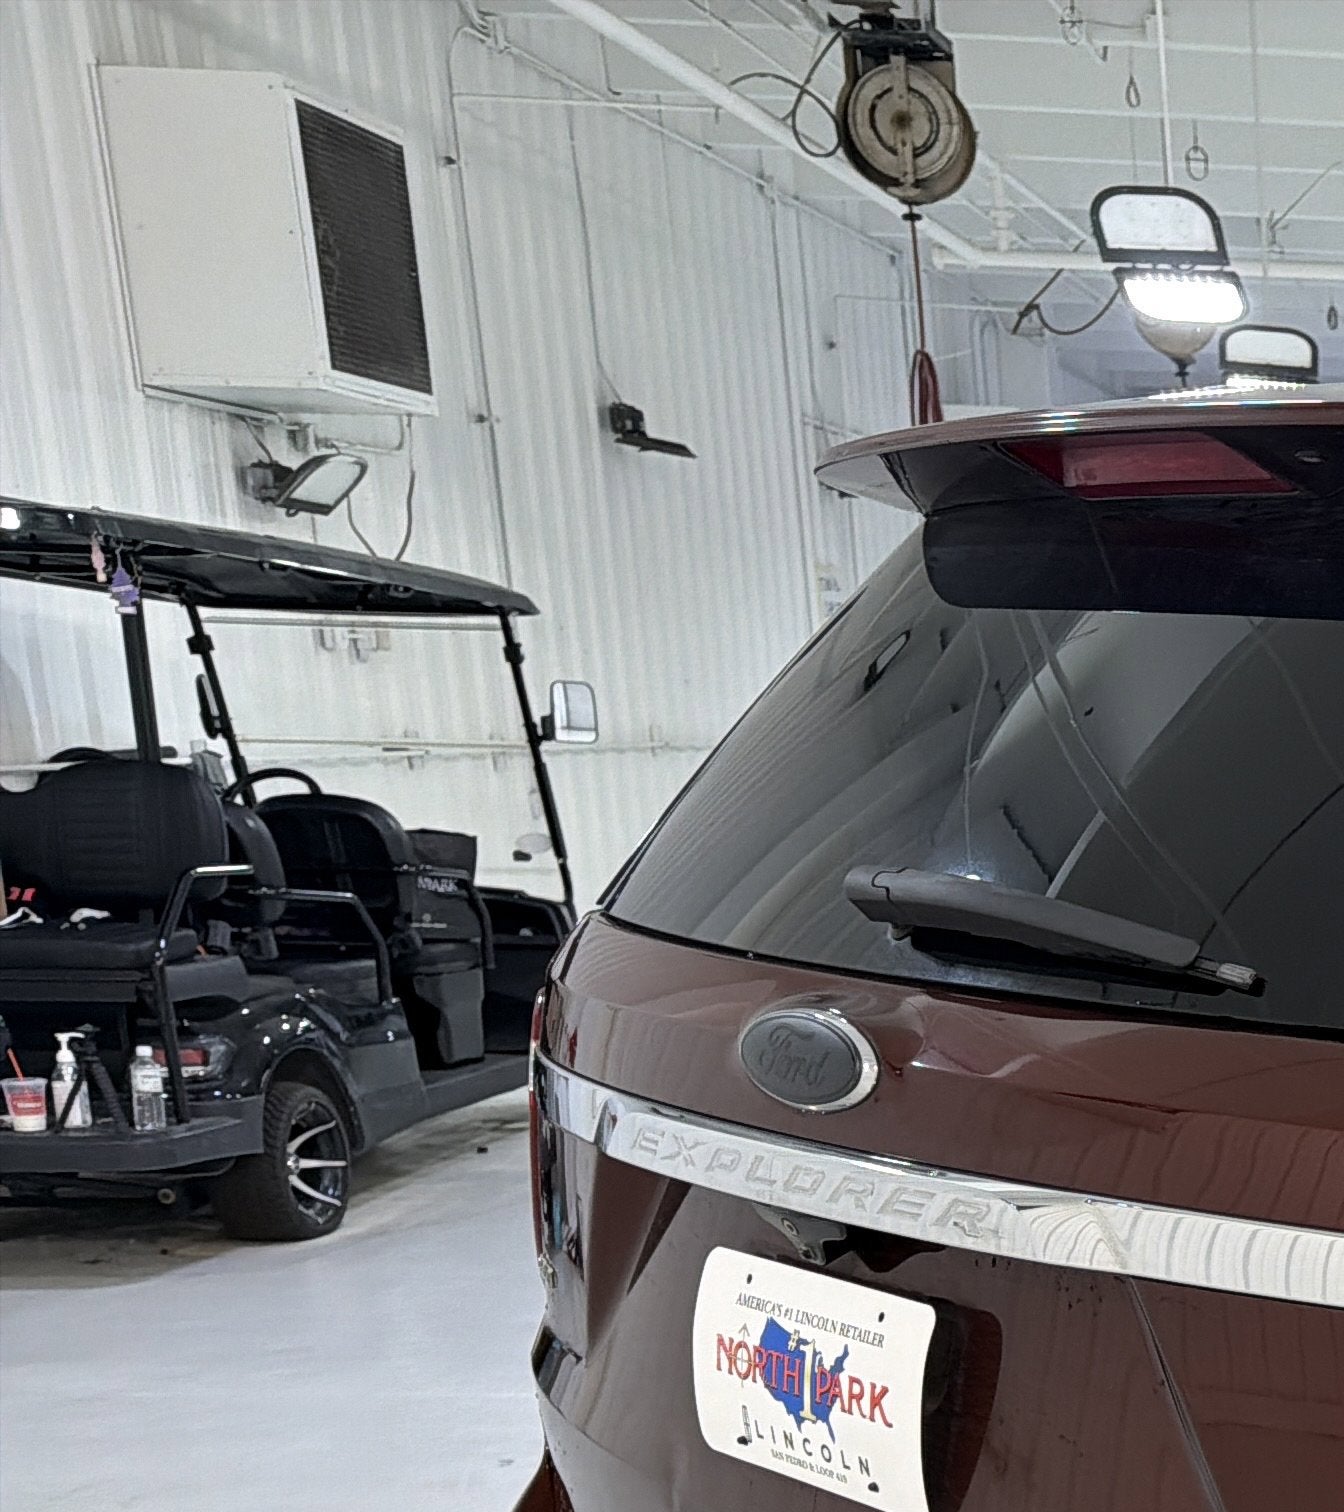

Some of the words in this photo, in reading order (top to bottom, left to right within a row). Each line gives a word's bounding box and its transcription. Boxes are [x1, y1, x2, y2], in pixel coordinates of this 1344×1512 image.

[757, 1023, 831, 1087] Ford
[631, 1126, 992, 1239] EXPLORER
[735, 1291, 784, 1318] AMERICA'S
[794, 1308, 839, 1334] LINCOLN
[838, 1321, 886, 1349] RETAILER
[715, 1333, 801, 1398] NORTH
[815, 1366, 894, 1429] PARK
[754, 1419, 872, 1478] LINCOLN
